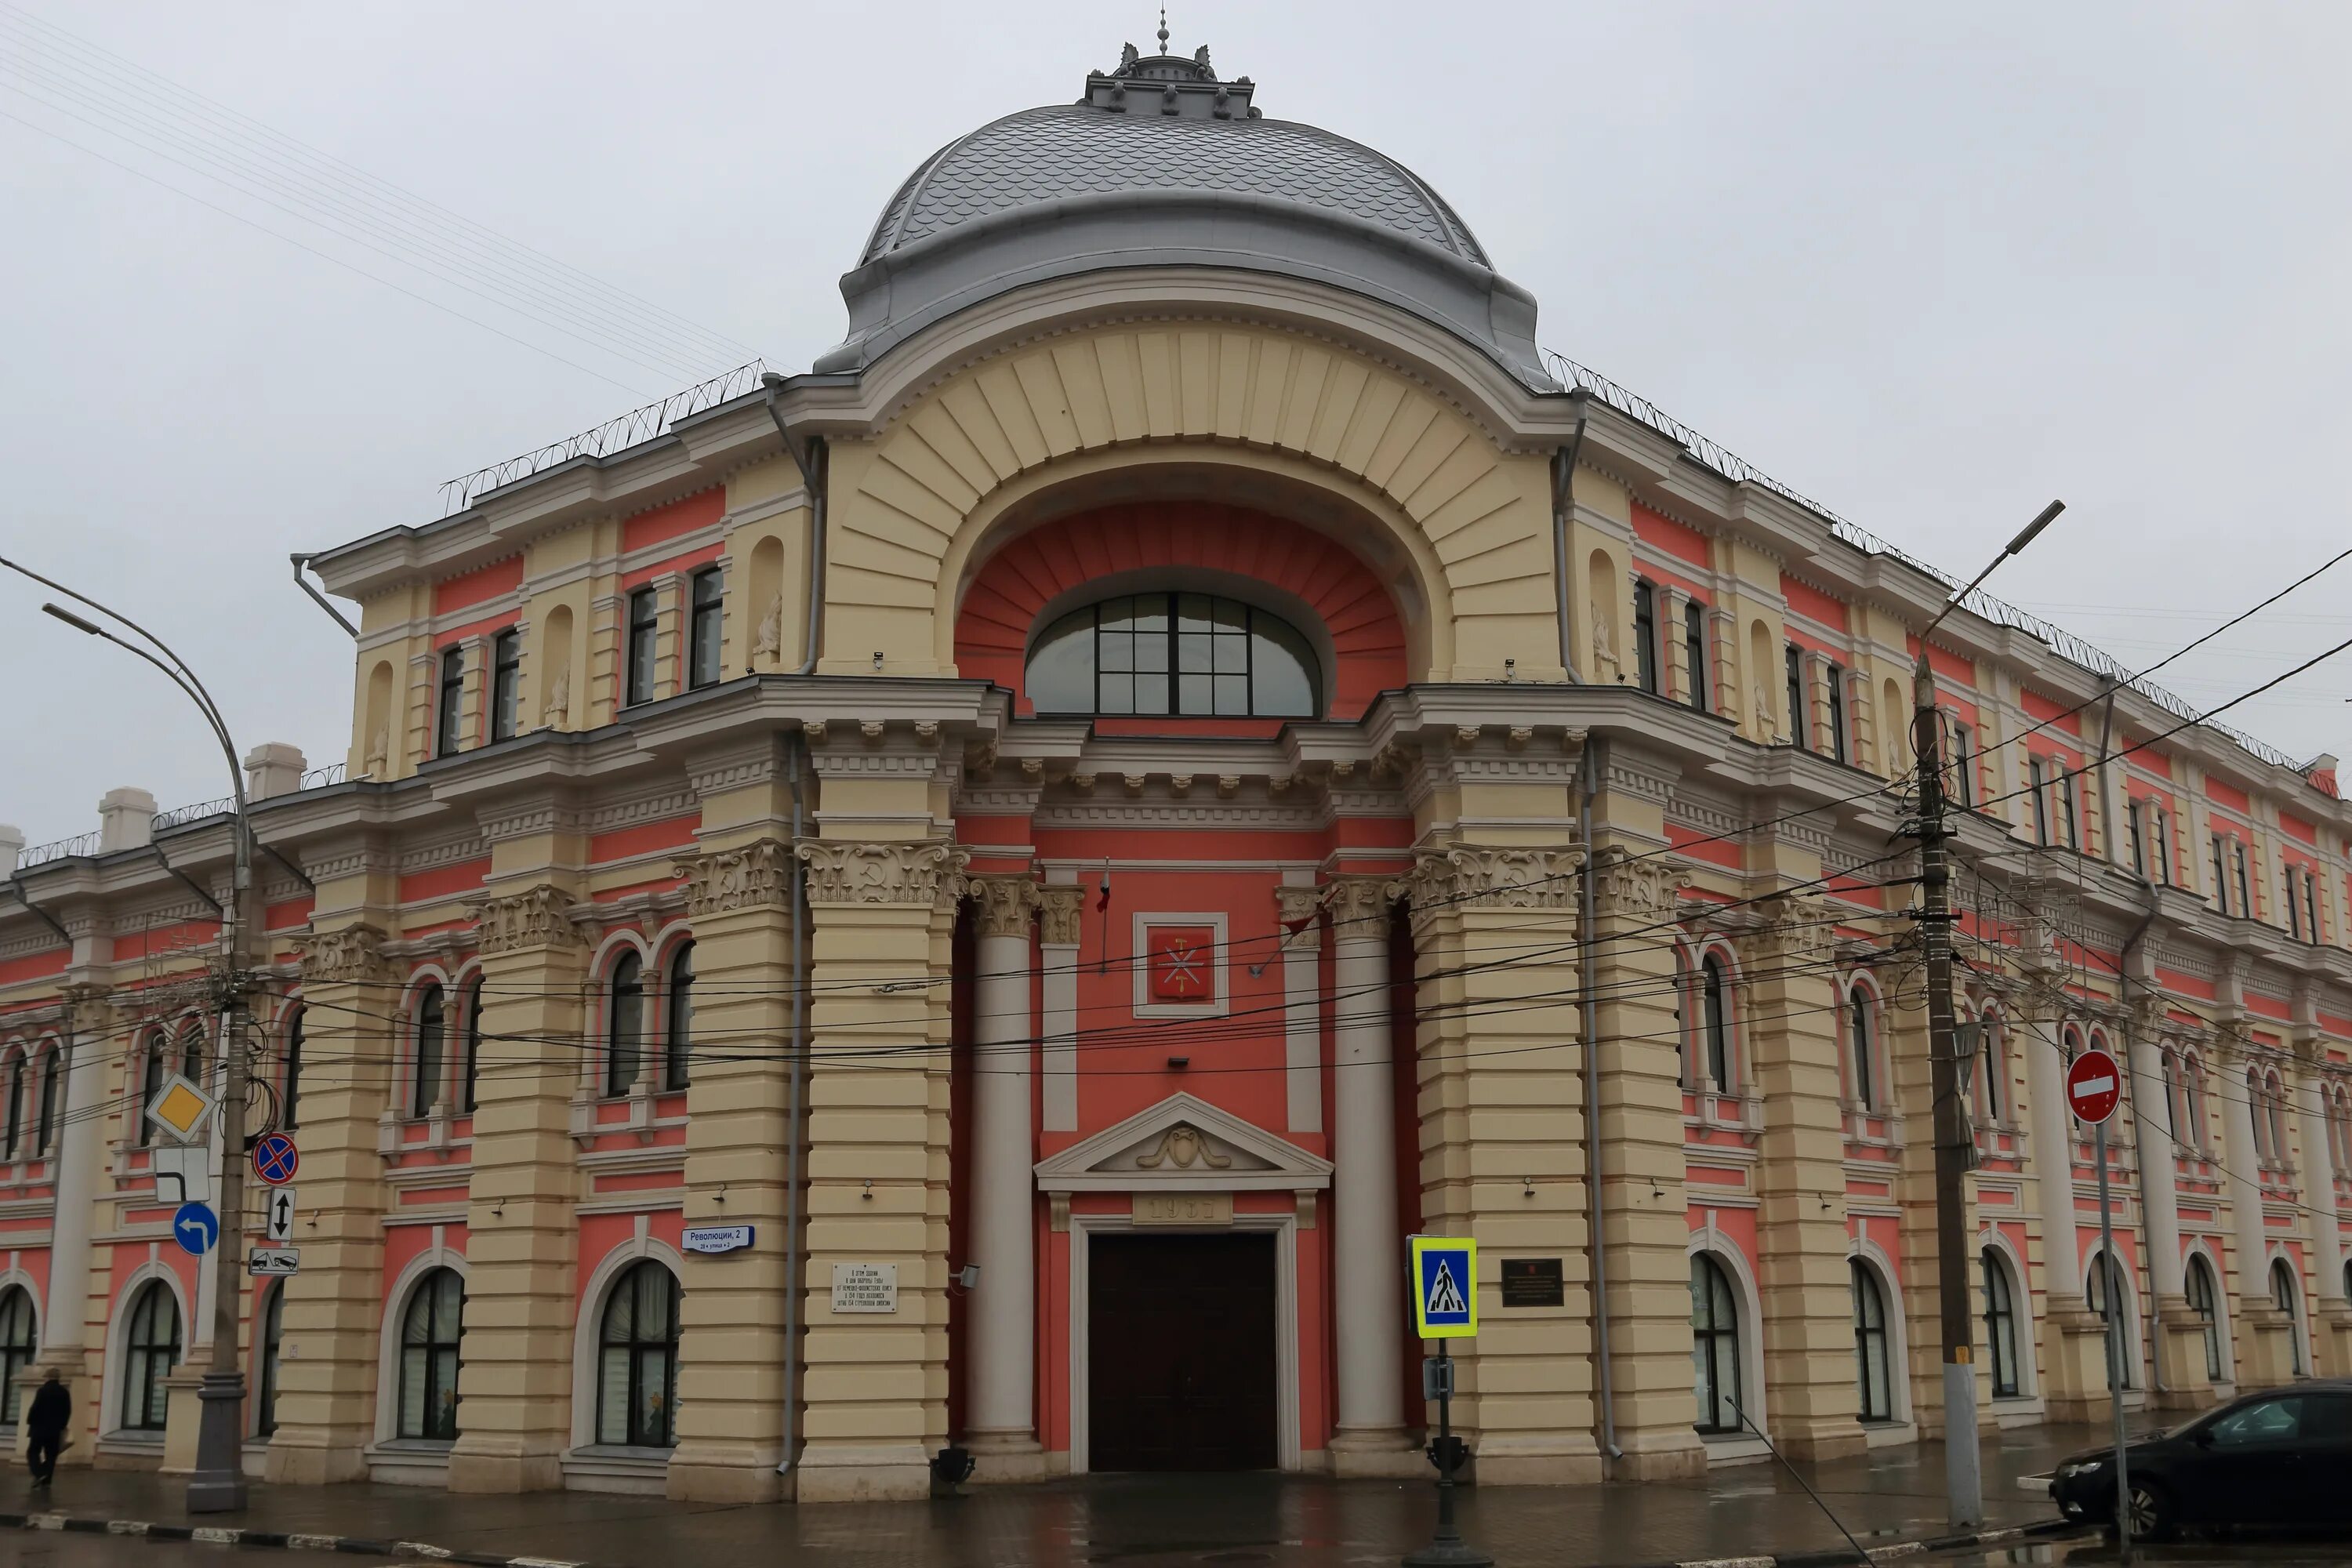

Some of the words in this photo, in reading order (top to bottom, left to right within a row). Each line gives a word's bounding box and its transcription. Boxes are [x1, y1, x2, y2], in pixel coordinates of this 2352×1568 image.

[1148, 1199, 1215, 1218] 1937
[690, 1232, 734, 1241] Революции,
[735, 1229, 740, 1239] 2
